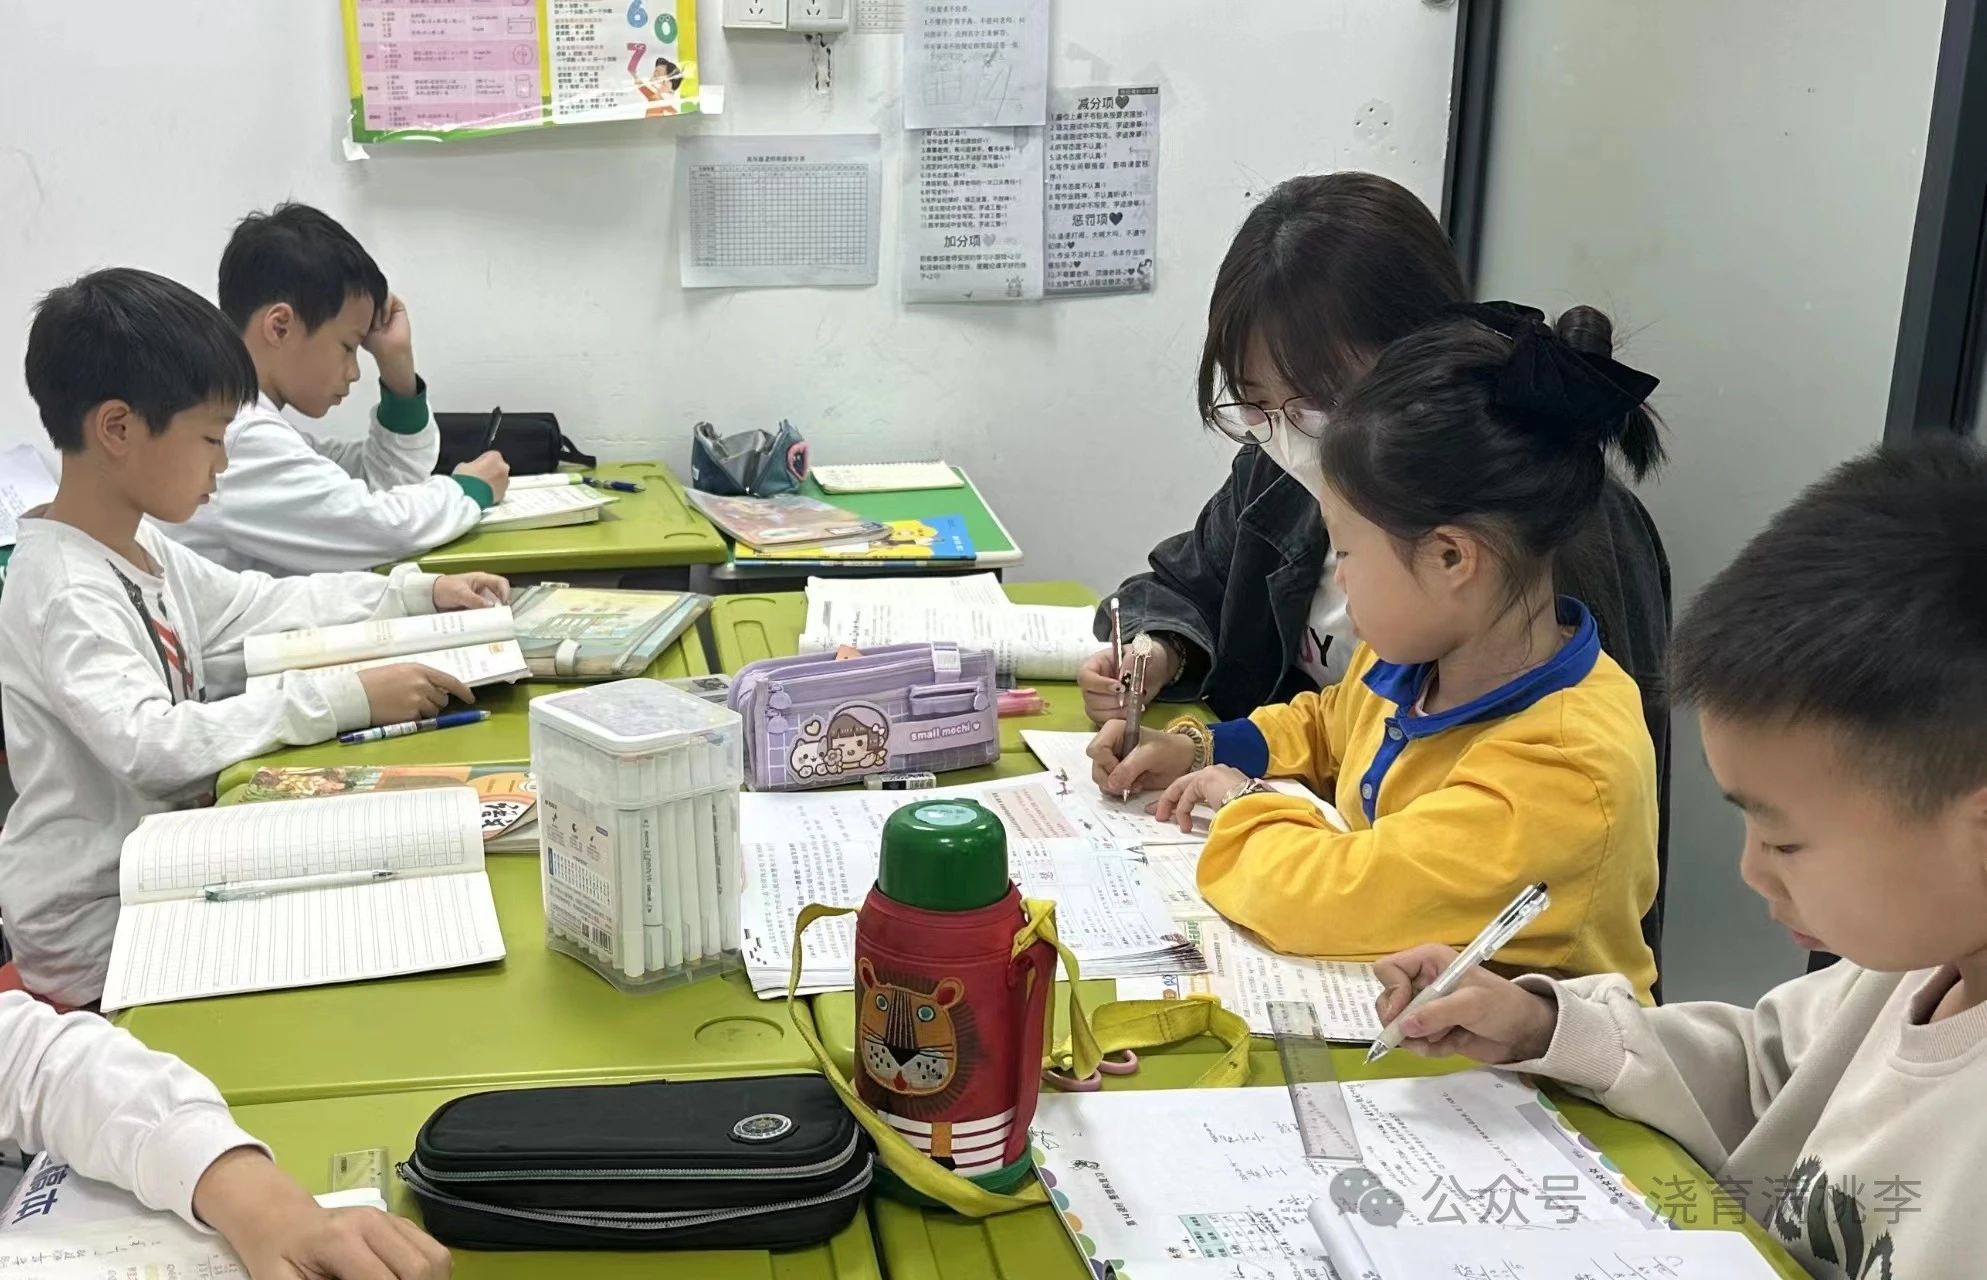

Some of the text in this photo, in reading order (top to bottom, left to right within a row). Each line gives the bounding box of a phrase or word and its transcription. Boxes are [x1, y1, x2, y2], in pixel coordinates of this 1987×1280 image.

[627, 0, 648, 28] 6
[626, 43, 647, 73] 7
[1077, 97, 1114, 110] 减分项
[1072, 213, 1108, 226] 惩罚项
[944, 235, 981, 248] 加分项
[911, 722, 971, 742] small mochi
